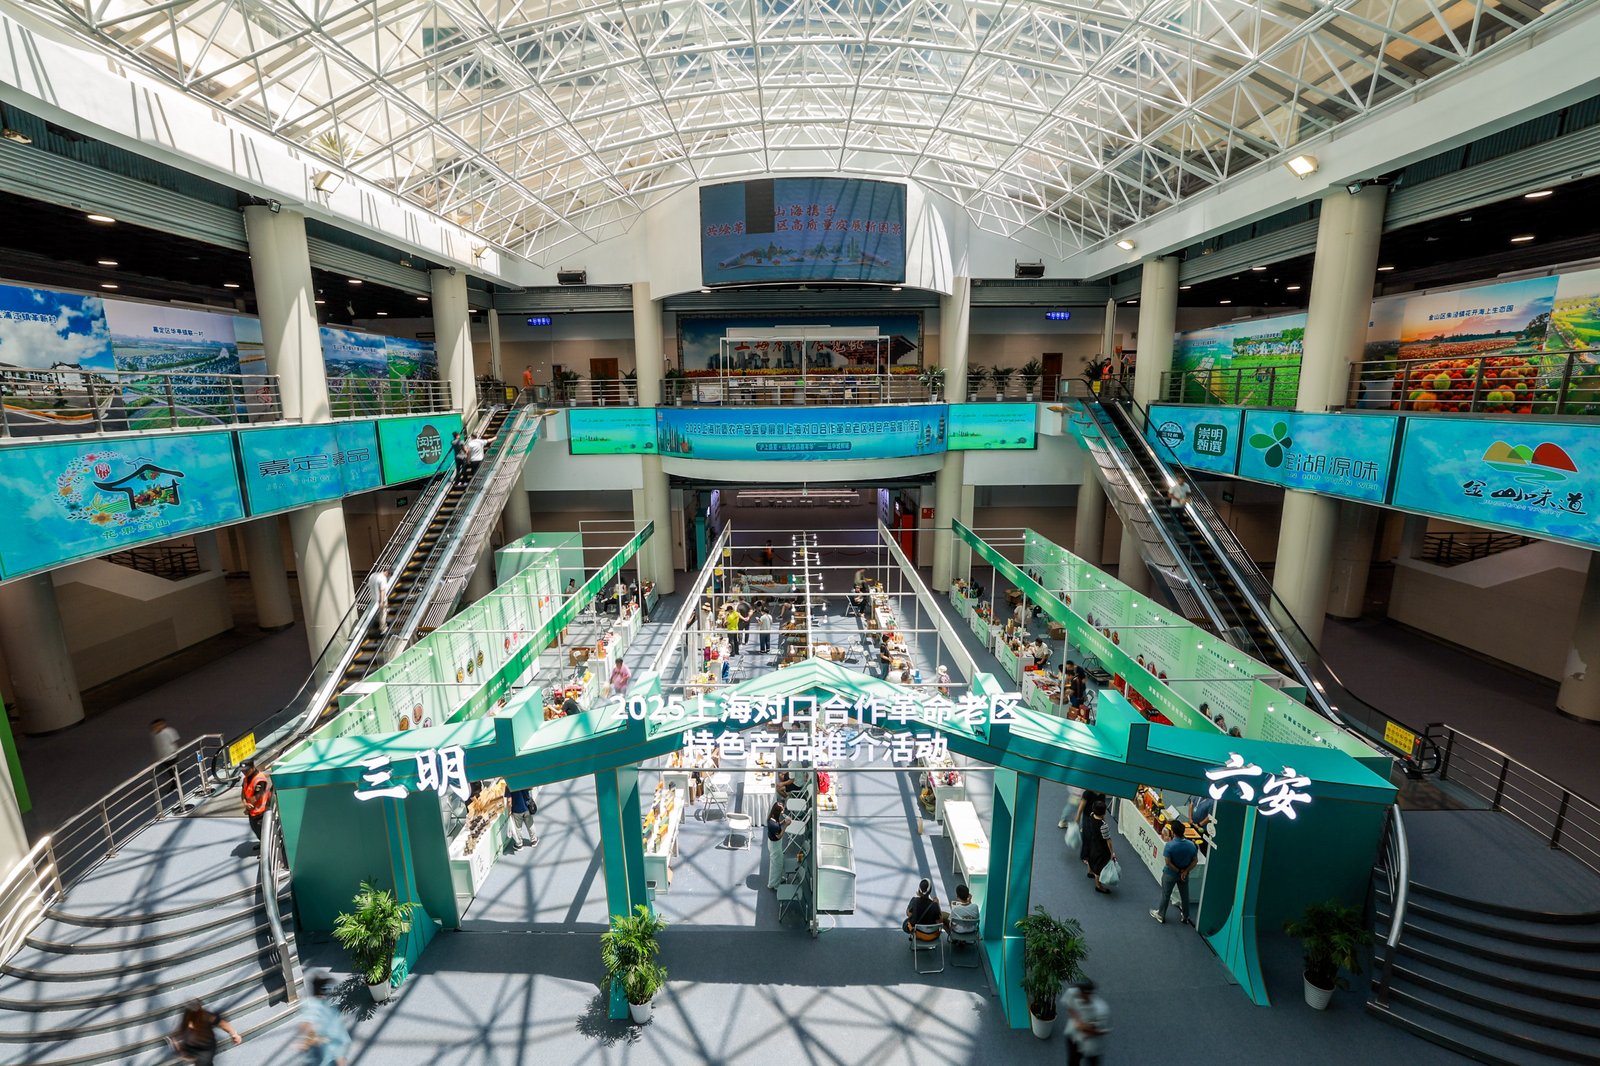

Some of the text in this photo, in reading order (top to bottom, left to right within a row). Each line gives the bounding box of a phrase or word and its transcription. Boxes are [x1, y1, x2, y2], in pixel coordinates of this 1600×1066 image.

[774, 204, 837, 218] 山海携手
[1428, 304, 1514, 321] 金山区朱泾镇花开海上生态园
[416, 435, 441, 448] 闵行
[1198, 427, 1224, 441] 崇明
[417, 445, 442, 459] 大米
[1197, 439, 1222, 453] 甄選
[1462, 479, 1588, 515] 金山味道
[609, 691, 1023, 725] 2025上海对口合作革命老区
[682, 729, 948, 764] 特色产品推介活动
[353, 744, 472, 802] 三明
[1204, 751, 1313, 820] 六安
